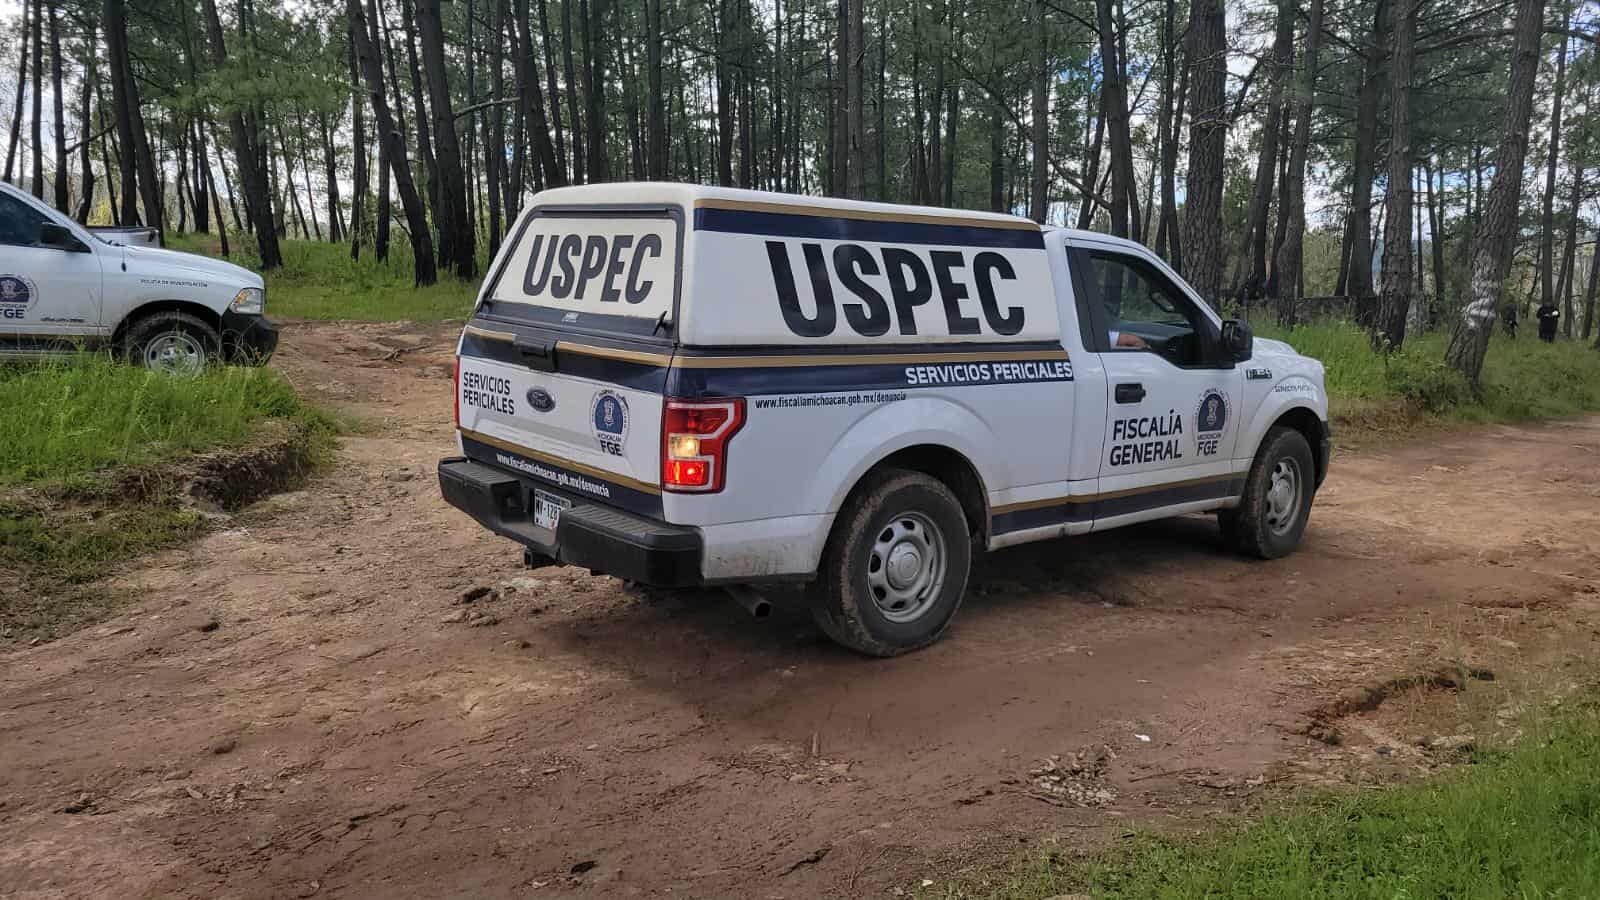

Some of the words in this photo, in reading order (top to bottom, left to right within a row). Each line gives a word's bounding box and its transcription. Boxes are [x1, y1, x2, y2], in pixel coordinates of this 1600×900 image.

[522, 232, 663, 305] USPEC
[765, 240, 1025, 338] USPEC
[463, 371, 511, 396] SERVICIOS
[905, 363, 990, 385] SERVICIOS
[993, 360, 1073, 381] PERICIALES
[463, 389, 515, 415] PERICIALES
[755, 391, 907, 409] www.fiscaliamichoacan.gob.mx/denuncia
[1112, 408, 1183, 441] FISCALÍA
[600, 439, 623, 457] FGE
[1109, 439, 1183, 466] GENERAL
[1196, 439, 1218, 456] FGE
